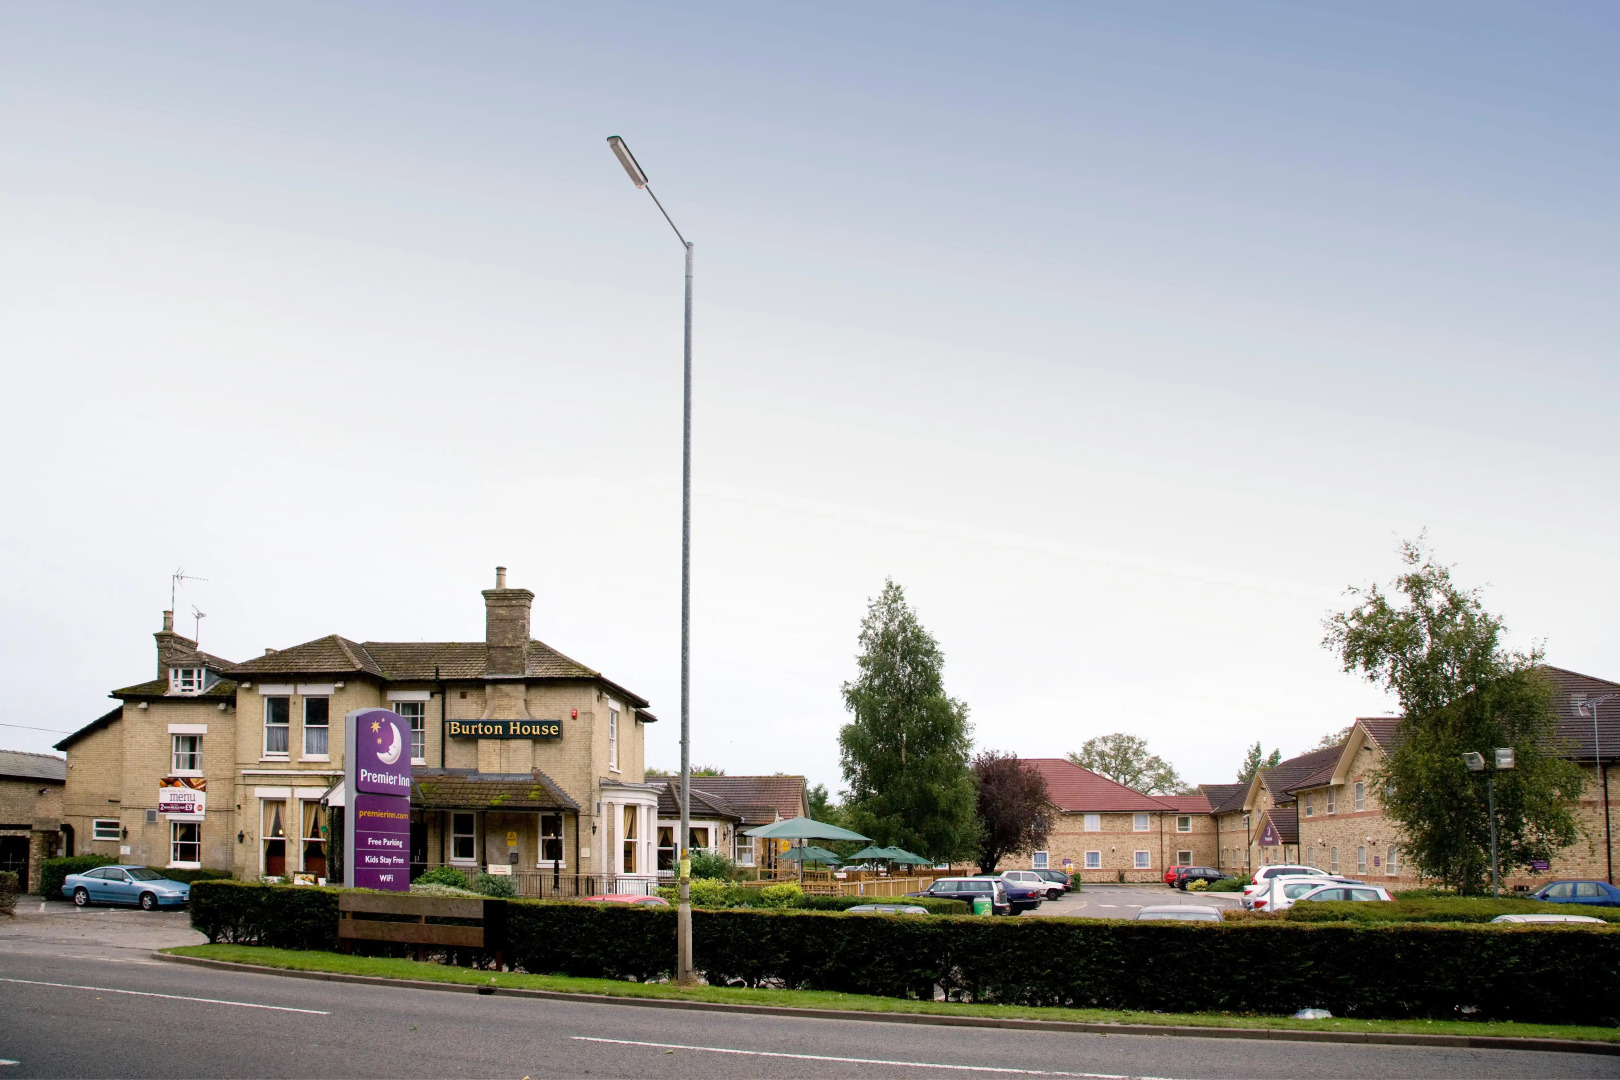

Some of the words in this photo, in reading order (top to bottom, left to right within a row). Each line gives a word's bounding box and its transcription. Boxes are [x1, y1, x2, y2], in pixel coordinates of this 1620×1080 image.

[450, 721, 503, 735] Burton
[509, 721, 559, 735] House
[360, 768, 398, 786] Premier
[398, 773, 410, 788] Inn
[169, 793, 196, 802] menu
[160, 803, 165, 811] 2
[185, 803, 193, 811] £9
[358, 809, 409, 820] premierinn.com
[368, 837, 382, 846] Free
[383, 838, 403, 849] Parking
[365, 855, 379, 864] Kids
[379, 855, 392, 866] Stay
[392, 856, 405, 864] Free
[379, 874, 394, 882] WiFi
